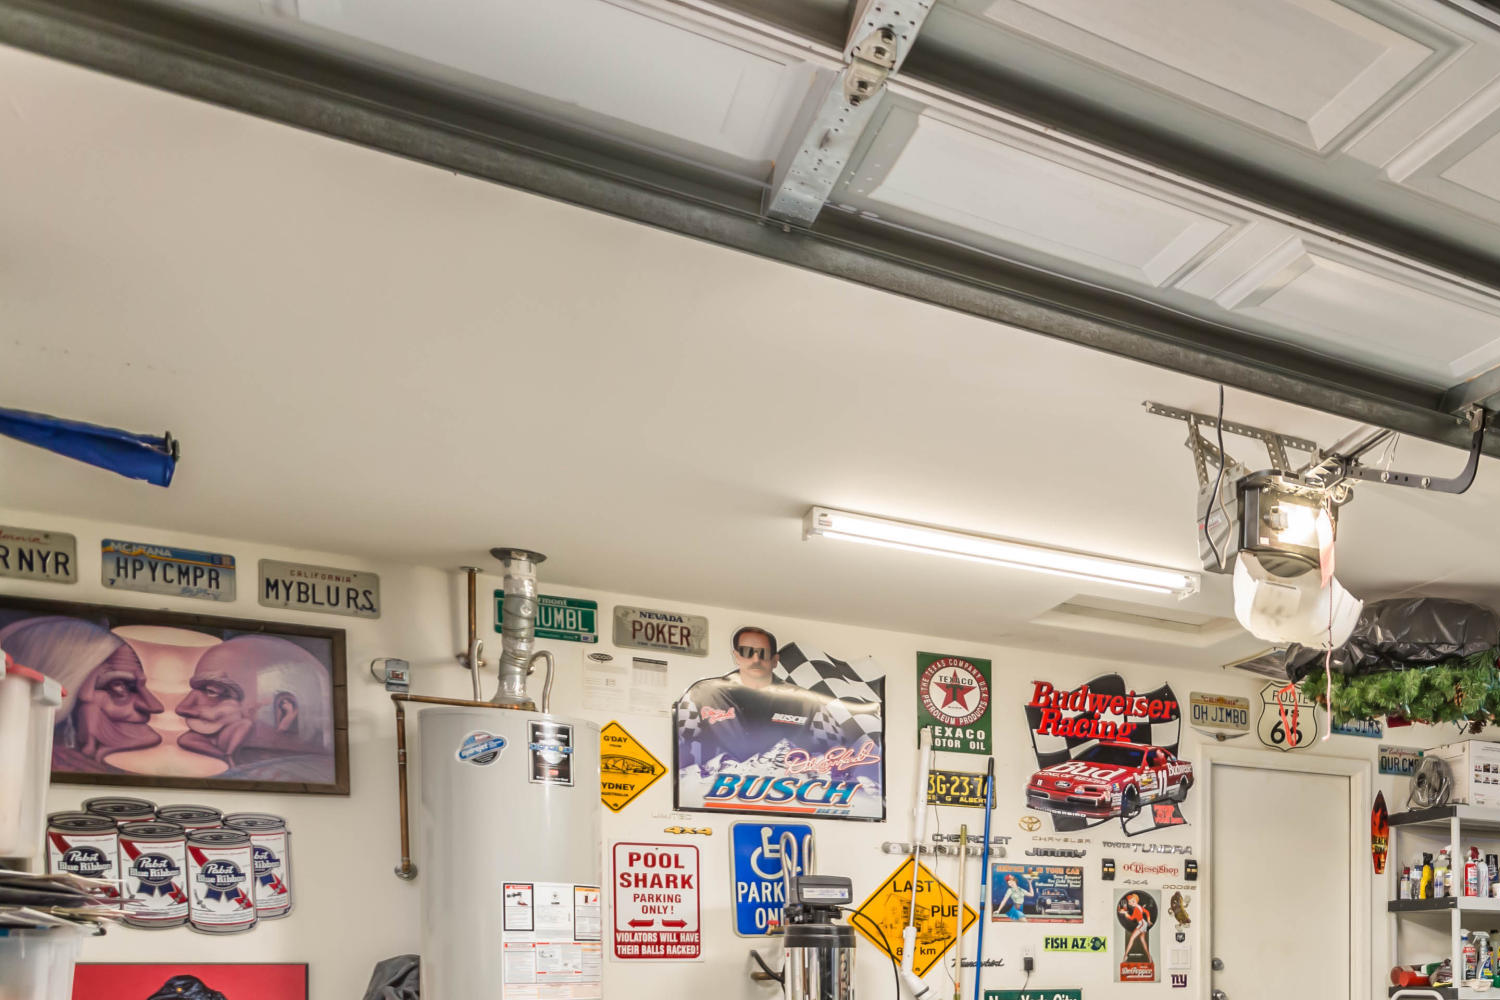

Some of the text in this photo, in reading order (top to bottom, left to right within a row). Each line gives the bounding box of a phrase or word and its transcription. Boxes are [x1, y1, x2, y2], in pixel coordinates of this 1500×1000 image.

[18, 549, 70, 577] NYR
[115, 557, 221, 590] HPYCMPR
[289, 569, 352, 583] CALIFORNIA
[639, 611, 684, 624] NEVADA
[632, 619, 691, 647] POKER
[938, 674, 974, 687] TEXACO
[1028, 680, 1177, 720] Budweiser
[922, 694, 988, 726] PETROLEUM PRODUCTS
[1193, 704, 1248, 725] OH JIMBO
[1036, 707, 1137, 743] Racing
[1270, 719, 1303, 745] 66
[932, 738, 986, 751] OTOR OIL
[1046, 760, 1127, 782] Bud
[601, 781, 636, 792] YDNEY
[703, 773, 862, 808] BUSCH
[70, 850, 99, 862] Pabst
[1131, 842, 1193, 856] TUNDRA
[79, 860, 113, 872] Ribbon
[140, 857, 168, 869] Pabst
[628, 851, 685, 869] POOL
[149, 867, 182, 878] Ribbon
[206, 864, 234, 875] Pabst
[196, 873, 246, 883] Blue Ribbon
[619, 872, 694, 890] SHARK
[737, 881, 785, 903] PARK
[893, 880, 934, 893] LAST
[633, 893, 681, 904] PARKING
[616, 932, 700, 943] VIOLATORS WILL HAVE
[1044, 935, 1087, 950] FISH AZ
[616, 944, 700, 955] THEIR BALLS RACKED!
[920, 946, 937, 956] km
